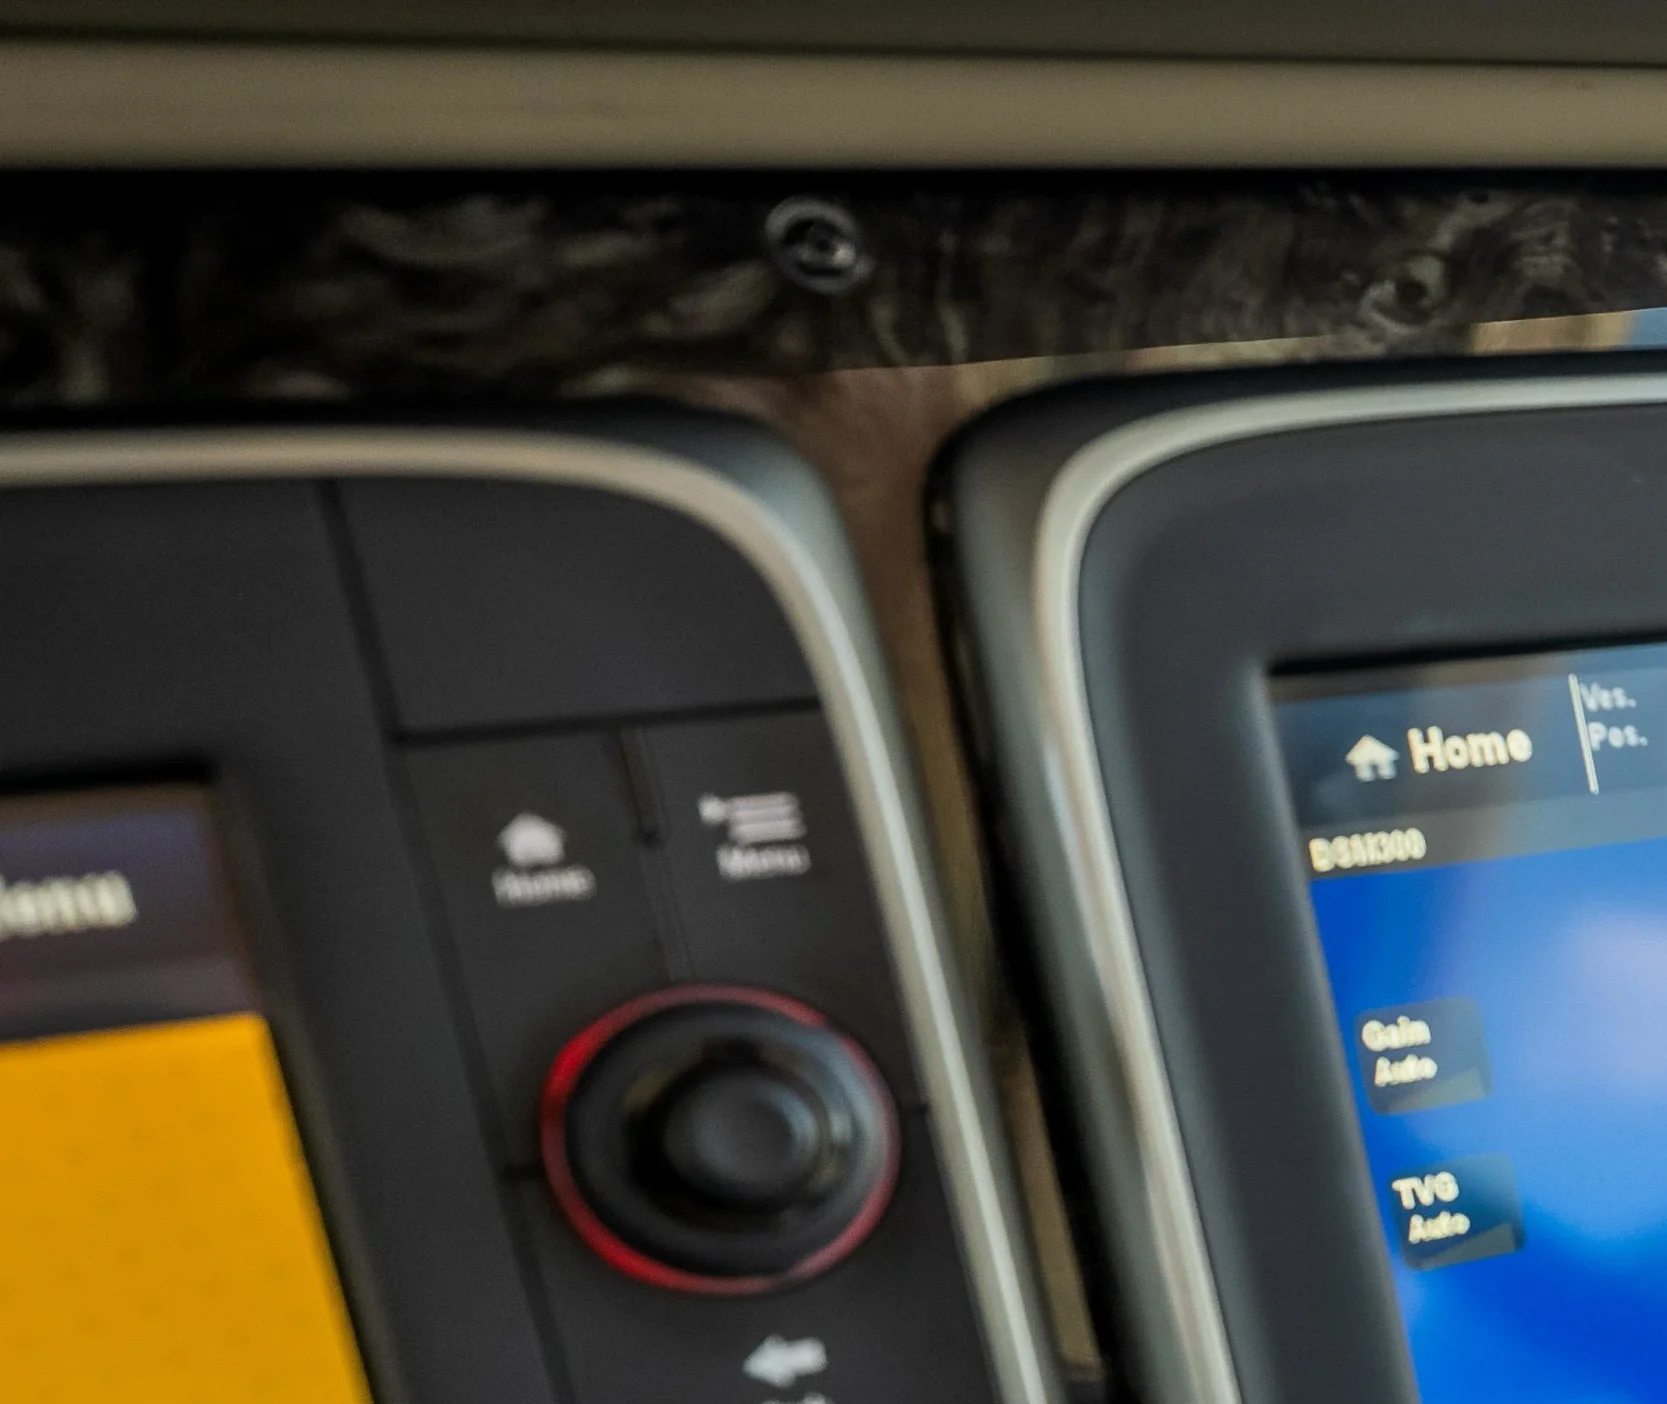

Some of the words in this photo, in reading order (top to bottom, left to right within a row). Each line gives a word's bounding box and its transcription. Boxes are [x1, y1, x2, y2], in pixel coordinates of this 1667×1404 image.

[1580, 682, 1637, 712] Ves.
[1407, 726, 1532, 774] Home
[1587, 721, 1648, 751] Pos.
[1362, 1016, 1431, 1051] Gain
[1374, 1054, 1437, 1087] Auto
[1392, 1172, 1459, 1210] TVG
[1408, 1211, 1470, 1244] Auto
